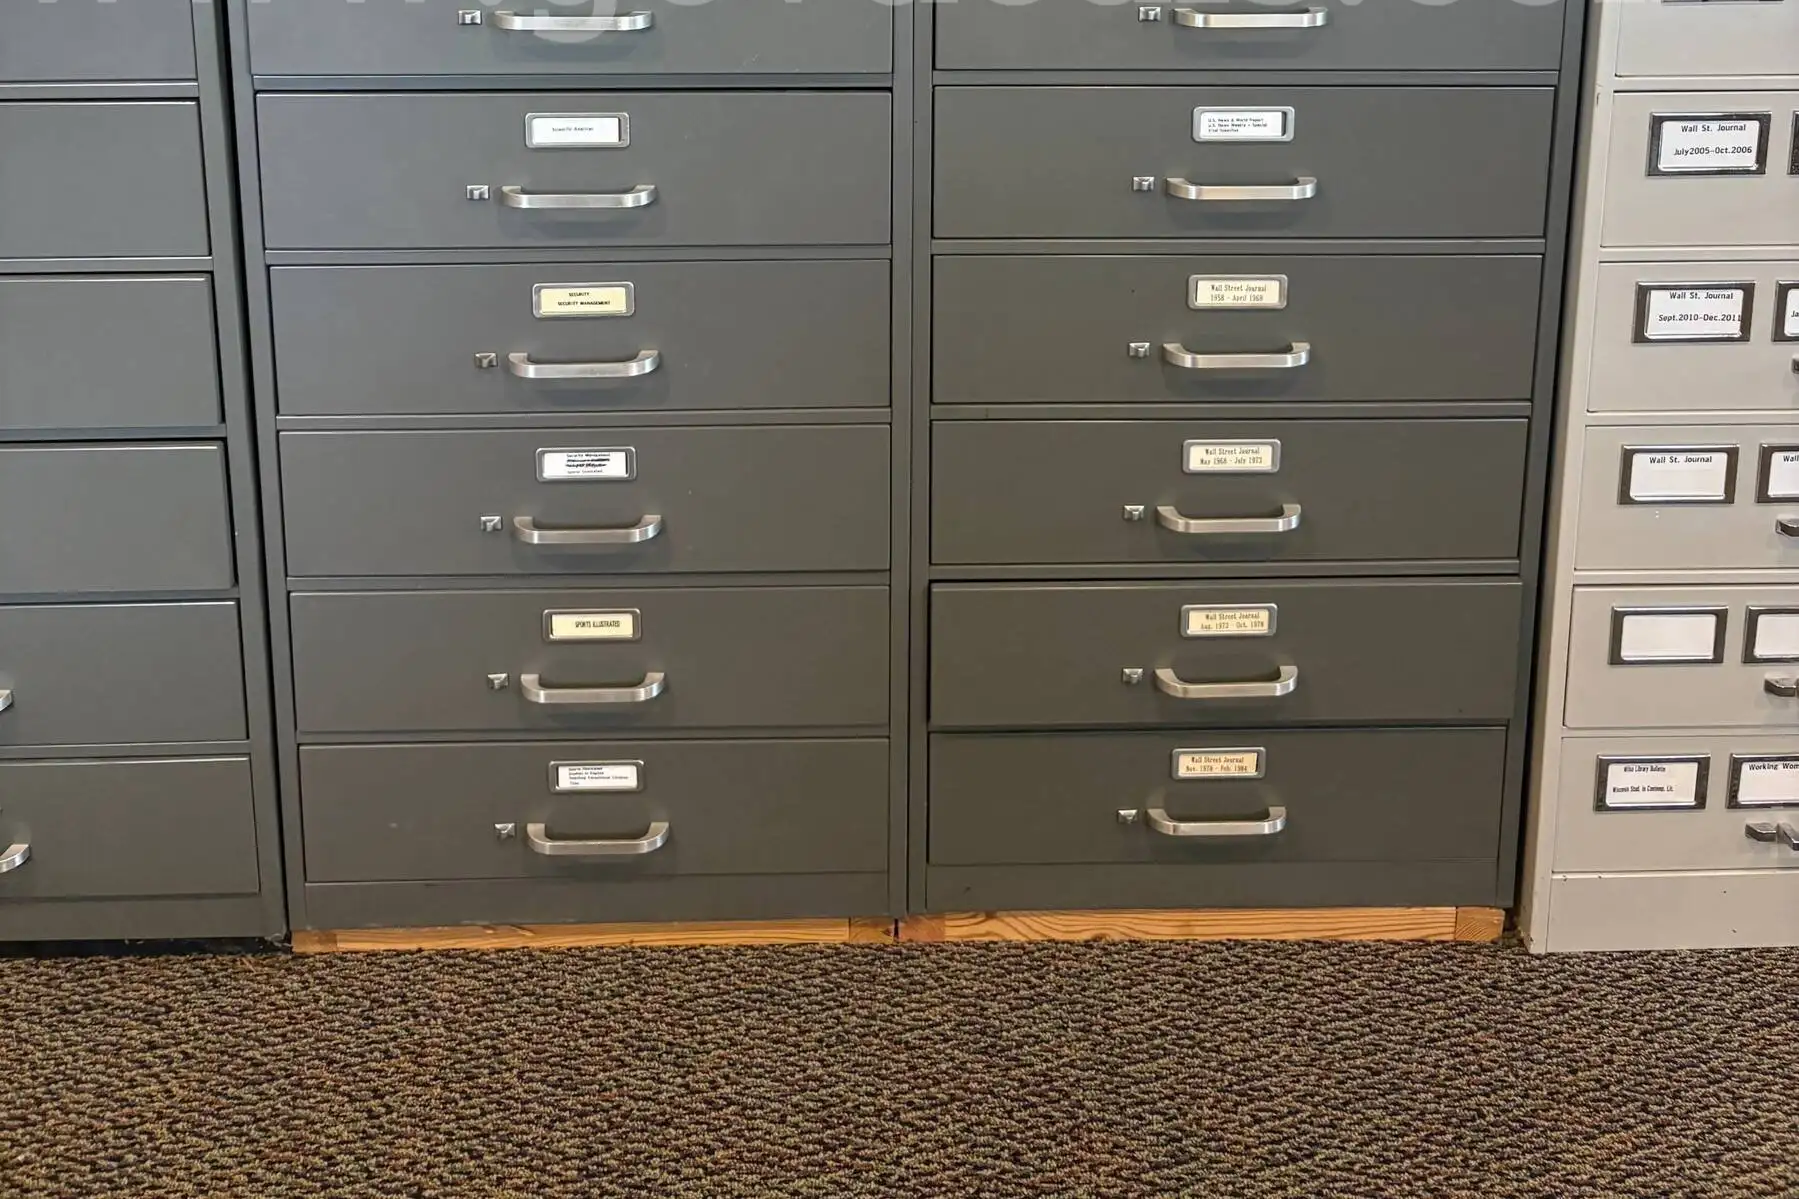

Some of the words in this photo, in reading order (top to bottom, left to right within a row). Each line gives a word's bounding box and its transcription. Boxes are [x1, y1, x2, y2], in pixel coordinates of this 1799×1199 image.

[1669, 292, 1686, 300] Wall
[1704, 292, 1733, 300] Journal
[1649, 456, 1666, 464] Wall
[1749, 763, 1778, 771] Working
